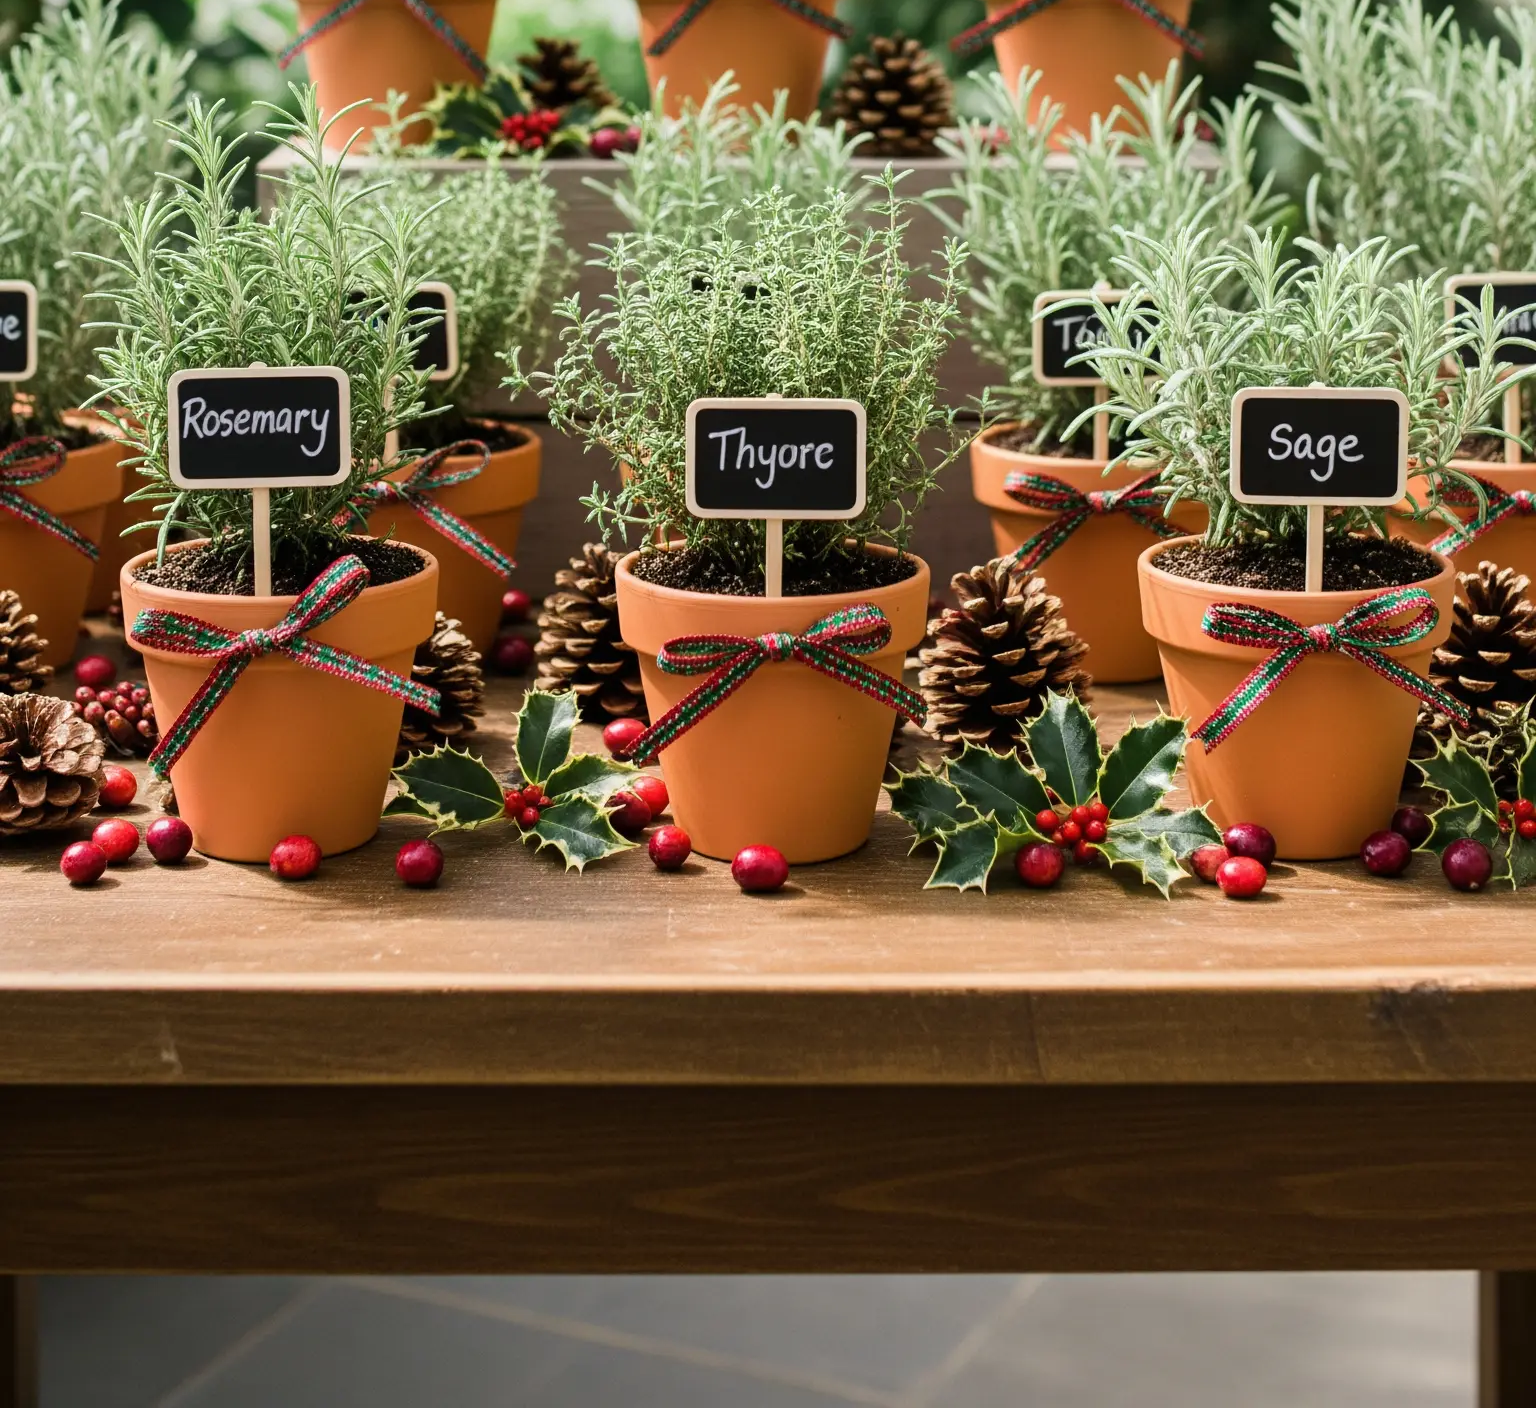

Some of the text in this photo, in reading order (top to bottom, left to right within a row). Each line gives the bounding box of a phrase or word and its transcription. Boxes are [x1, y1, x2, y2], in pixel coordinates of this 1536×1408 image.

[182, 397, 329, 457] Rosemary
[1267, 423, 1364, 482] Sage
[708, 426, 834, 489] Thyore
